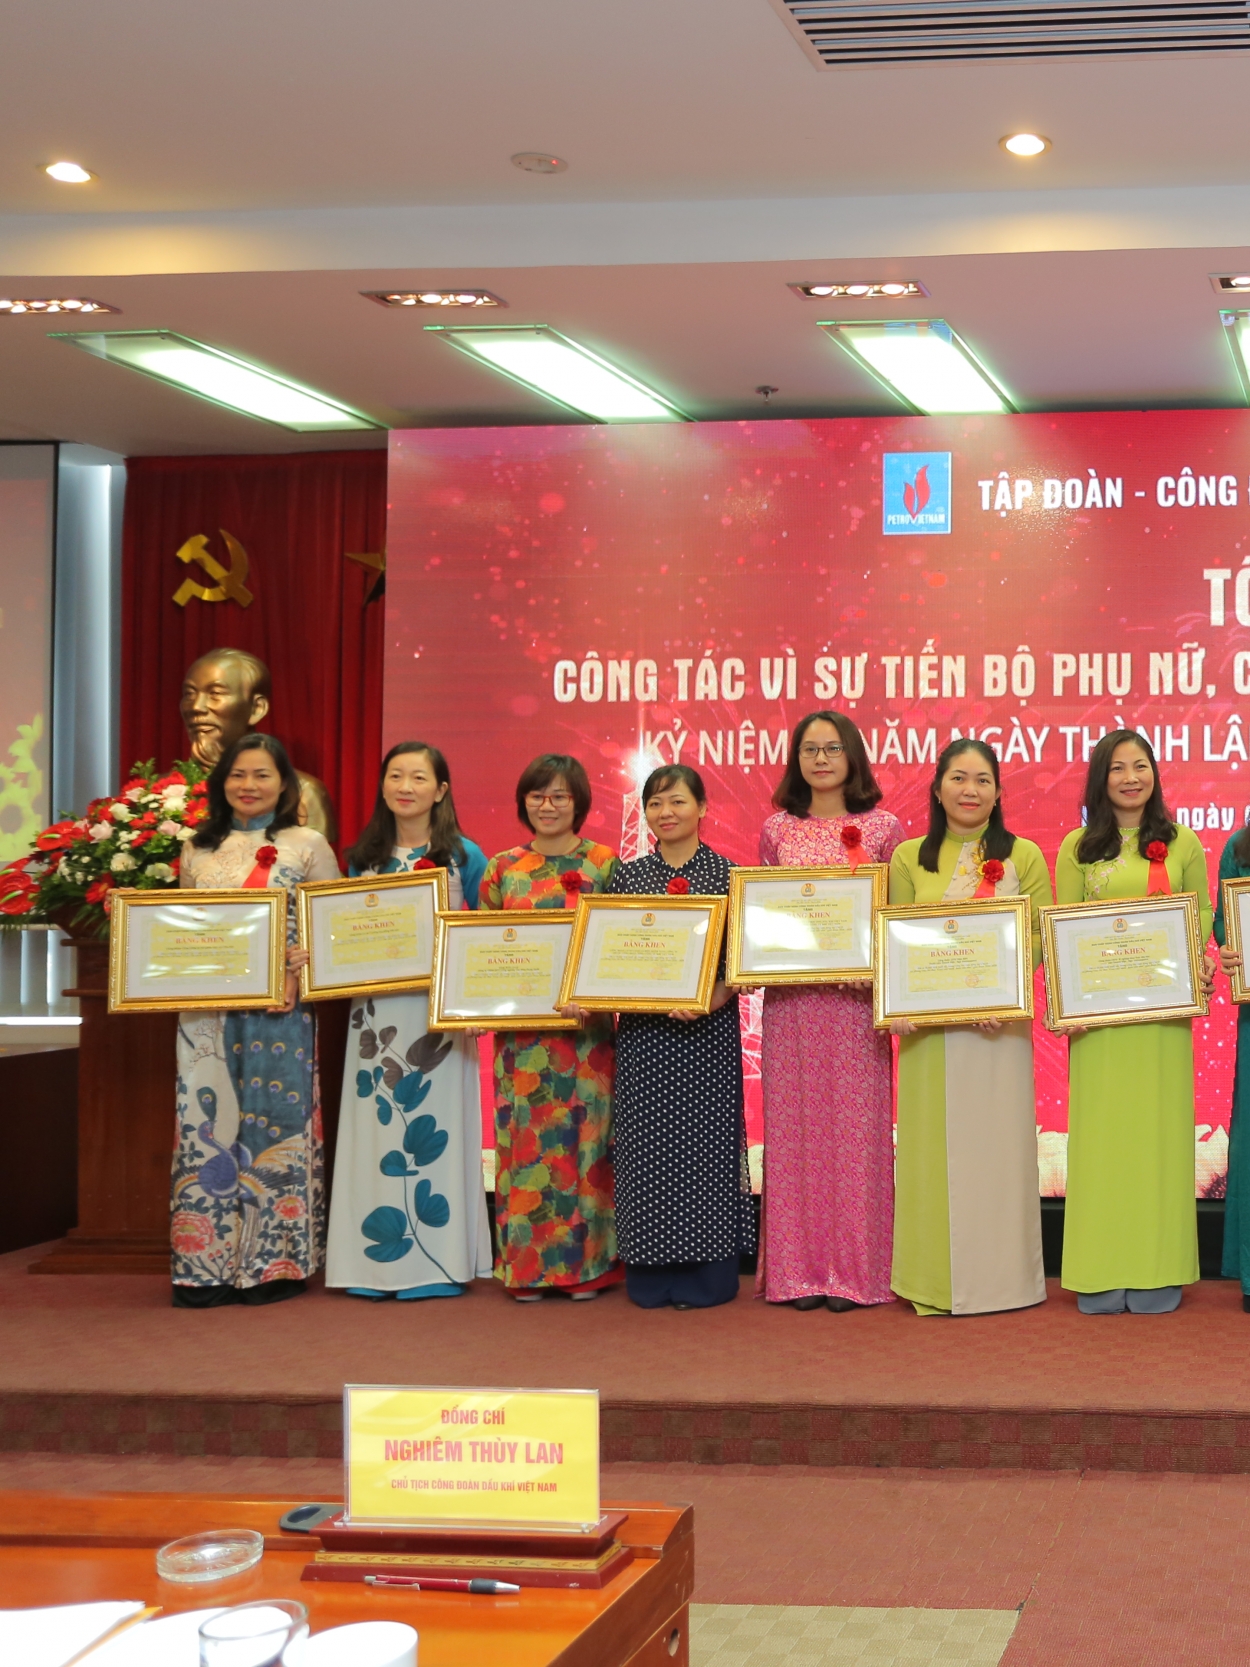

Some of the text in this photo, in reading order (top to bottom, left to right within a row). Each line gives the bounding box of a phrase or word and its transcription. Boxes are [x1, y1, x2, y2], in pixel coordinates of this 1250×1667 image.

[978, 471, 1033, 517] TẬP
[1042, 468, 1123, 509] ĐOÀN
[1156, 466, 1238, 507] CÔNG
[553, 650, 658, 703] CÔNG
[673, 649, 746, 701] TÁC
[760, 647, 798, 700] VÌ
[814, 650, 868, 708] SỰ
[881, 638, 966, 699] TIẾN
[983, 644, 1036, 706] BỘ
[1053, 651, 1132, 706] PHỤ
[1149, 642, 1216, 698] NỮ,
[644, 717, 688, 765] KỶ
[698, 719, 789, 774] NIỆM
[1058, 715, 1190, 763] THNH
[1176, 802, 1236, 831] ngày
[482, 1407, 506, 1426] CHÍ
[385, 1436, 564, 1465] NGHIÊM THÙY LAN
[391, 1476, 408, 1489] CHỦ
[410, 1479, 429, 1491] TỊCH
[431, 1478, 454, 1490] CÔNG
[500, 1480, 515, 1491] KHÍ
[517, 1480, 535, 1493] VIỆT
[537, 1482, 557, 1492] NAM
